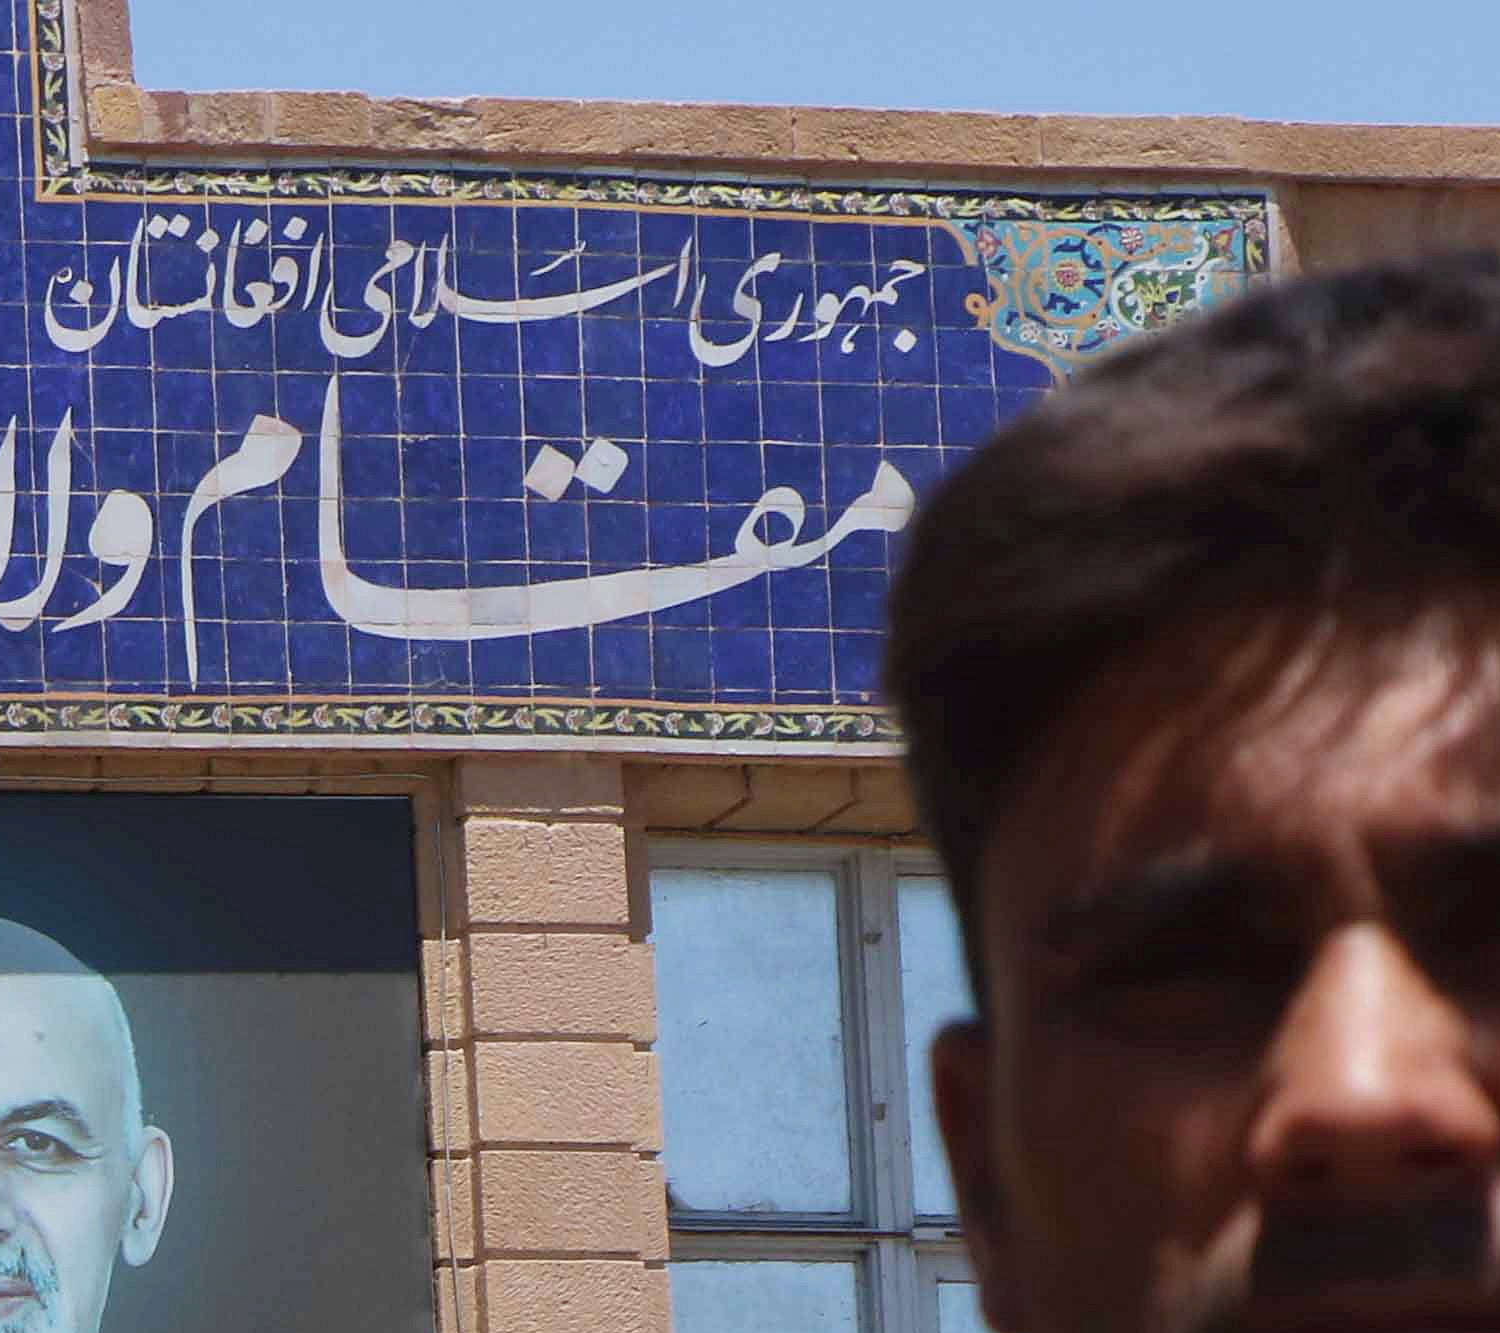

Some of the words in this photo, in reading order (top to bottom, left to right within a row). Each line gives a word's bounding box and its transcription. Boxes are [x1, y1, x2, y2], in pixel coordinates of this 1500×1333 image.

[44, 213, 325, 352] افغانستان
[319, 236, 693, 359] اسلامی
[690, 251, 927, 368] جمهوری
[180, 374, 917, 692] مقام
